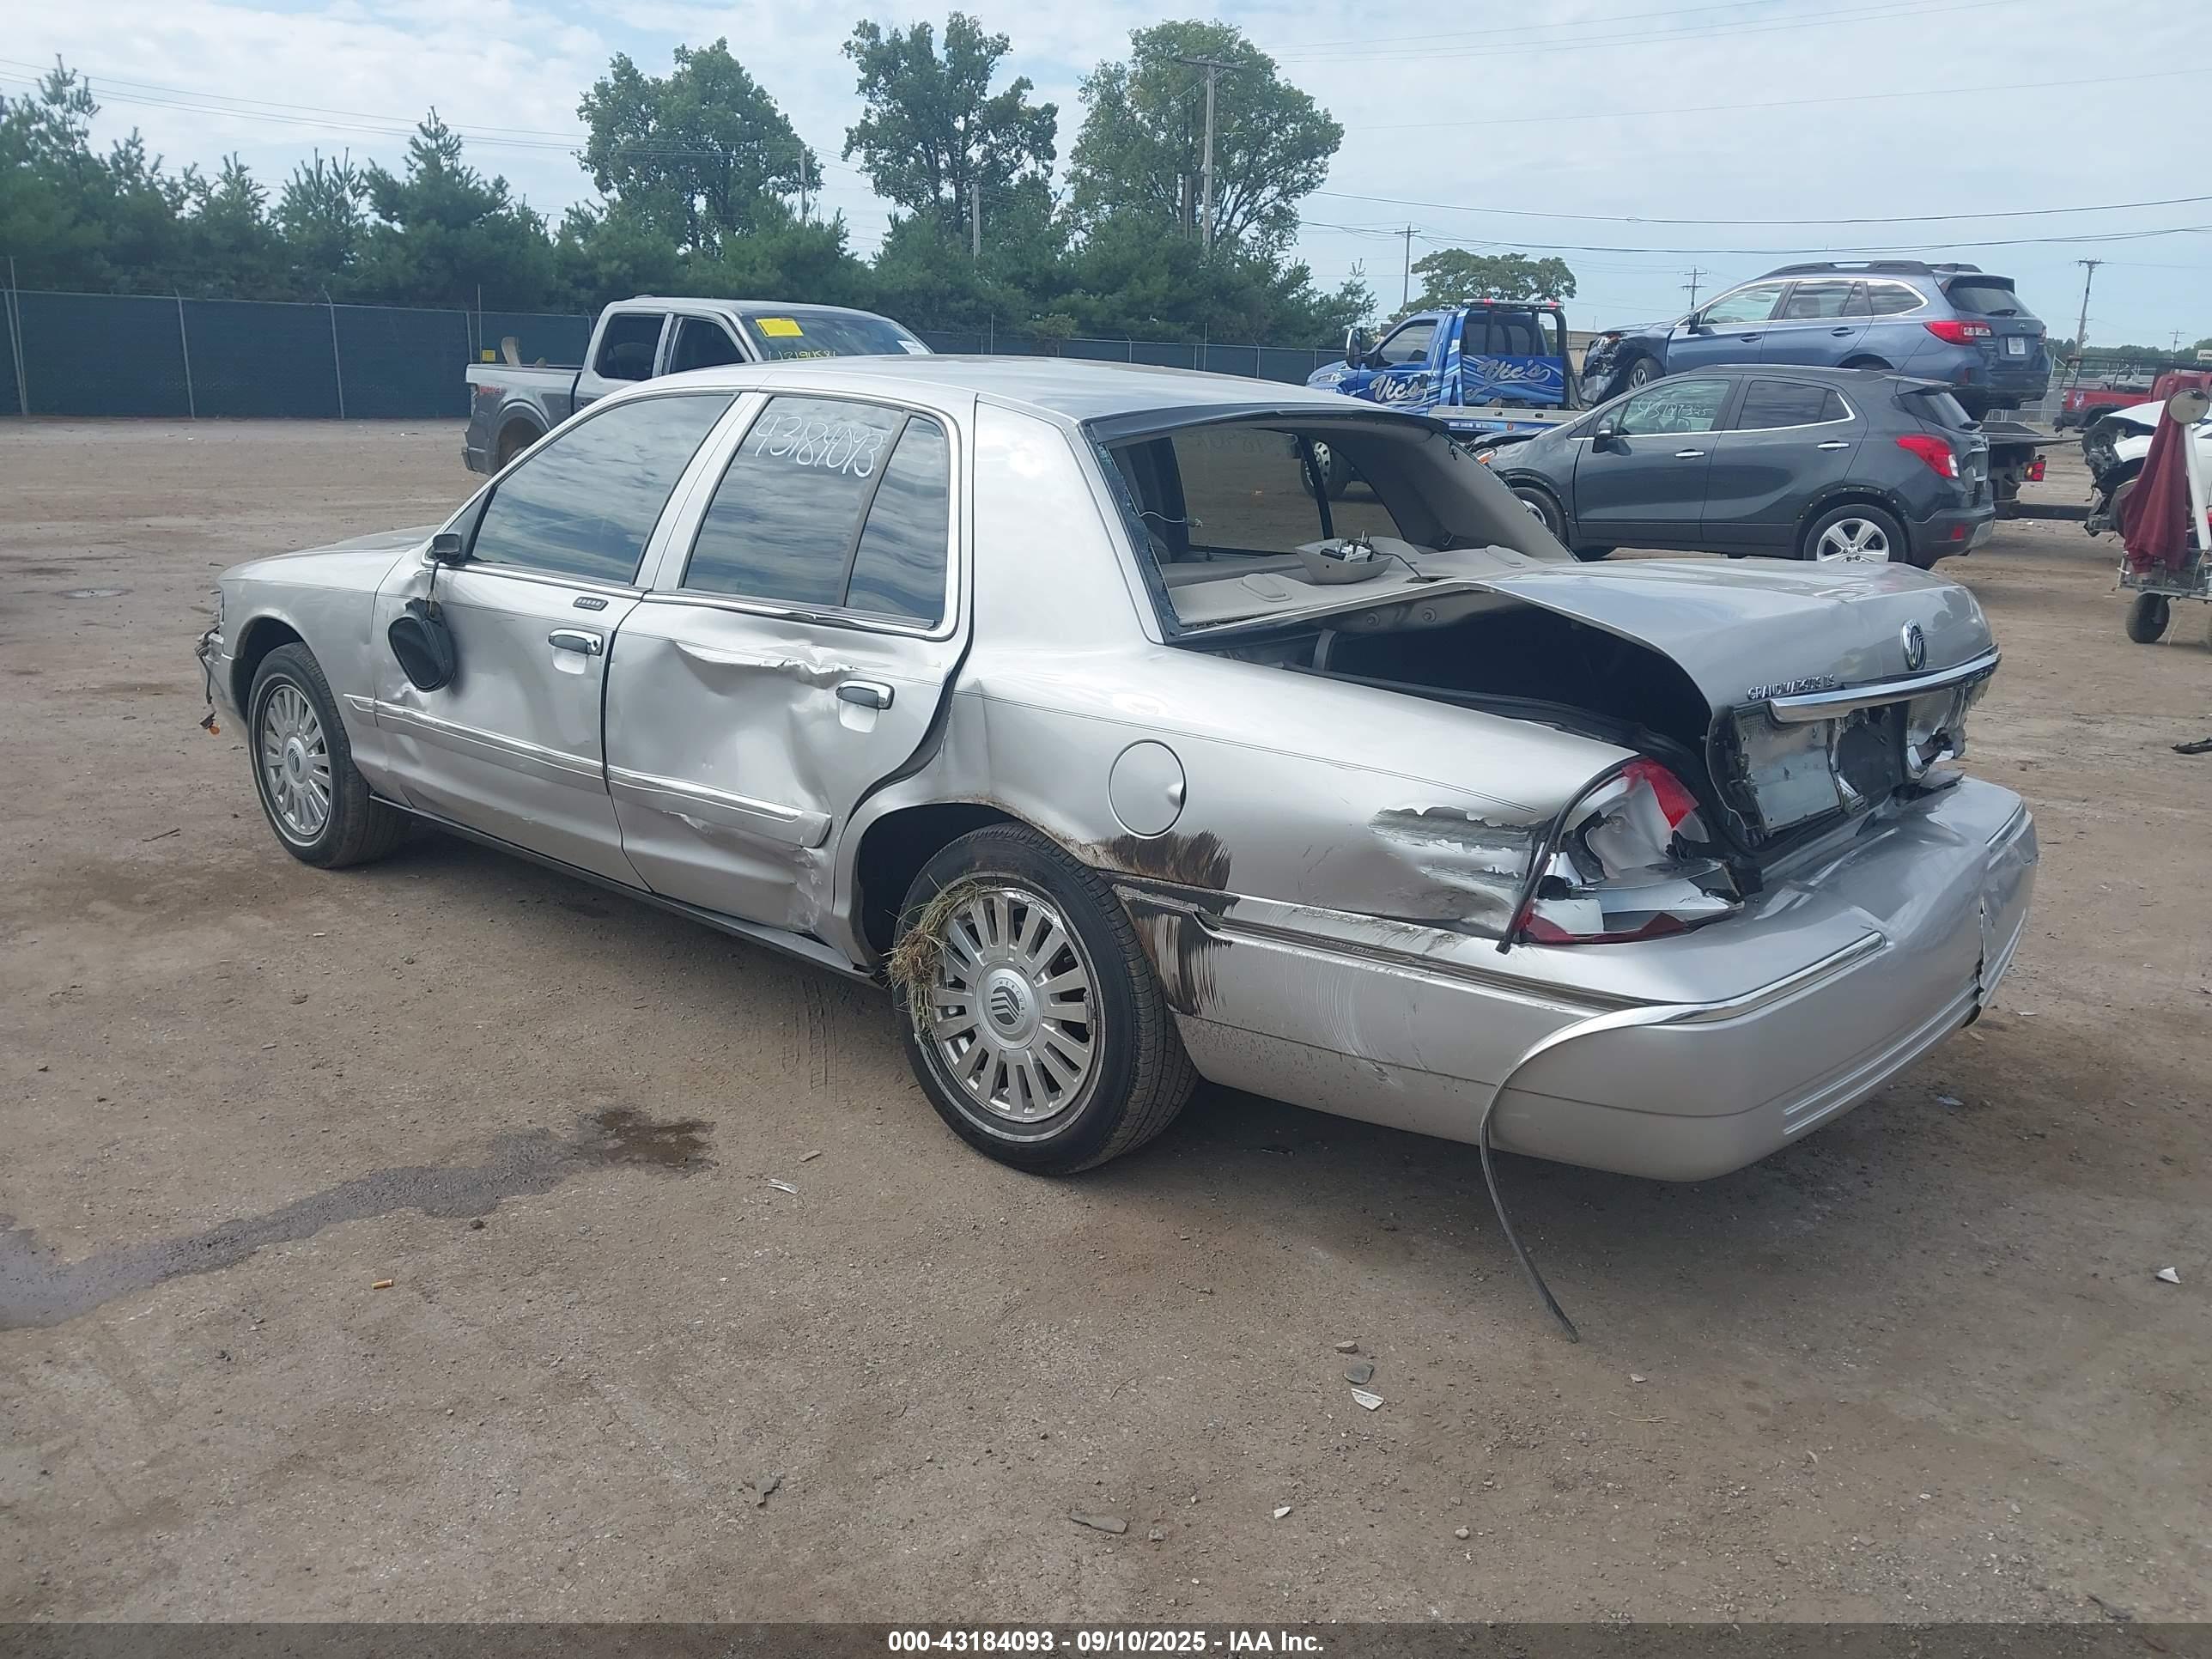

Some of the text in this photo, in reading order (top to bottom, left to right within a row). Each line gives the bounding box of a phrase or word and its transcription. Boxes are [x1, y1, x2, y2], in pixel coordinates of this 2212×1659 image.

[1477, 359, 1547, 380] Vic's
[1369, 374, 1425, 401] Vic's
[756, 414, 884, 477] 43184093
[1747, 684, 1782, 700] GRAND
